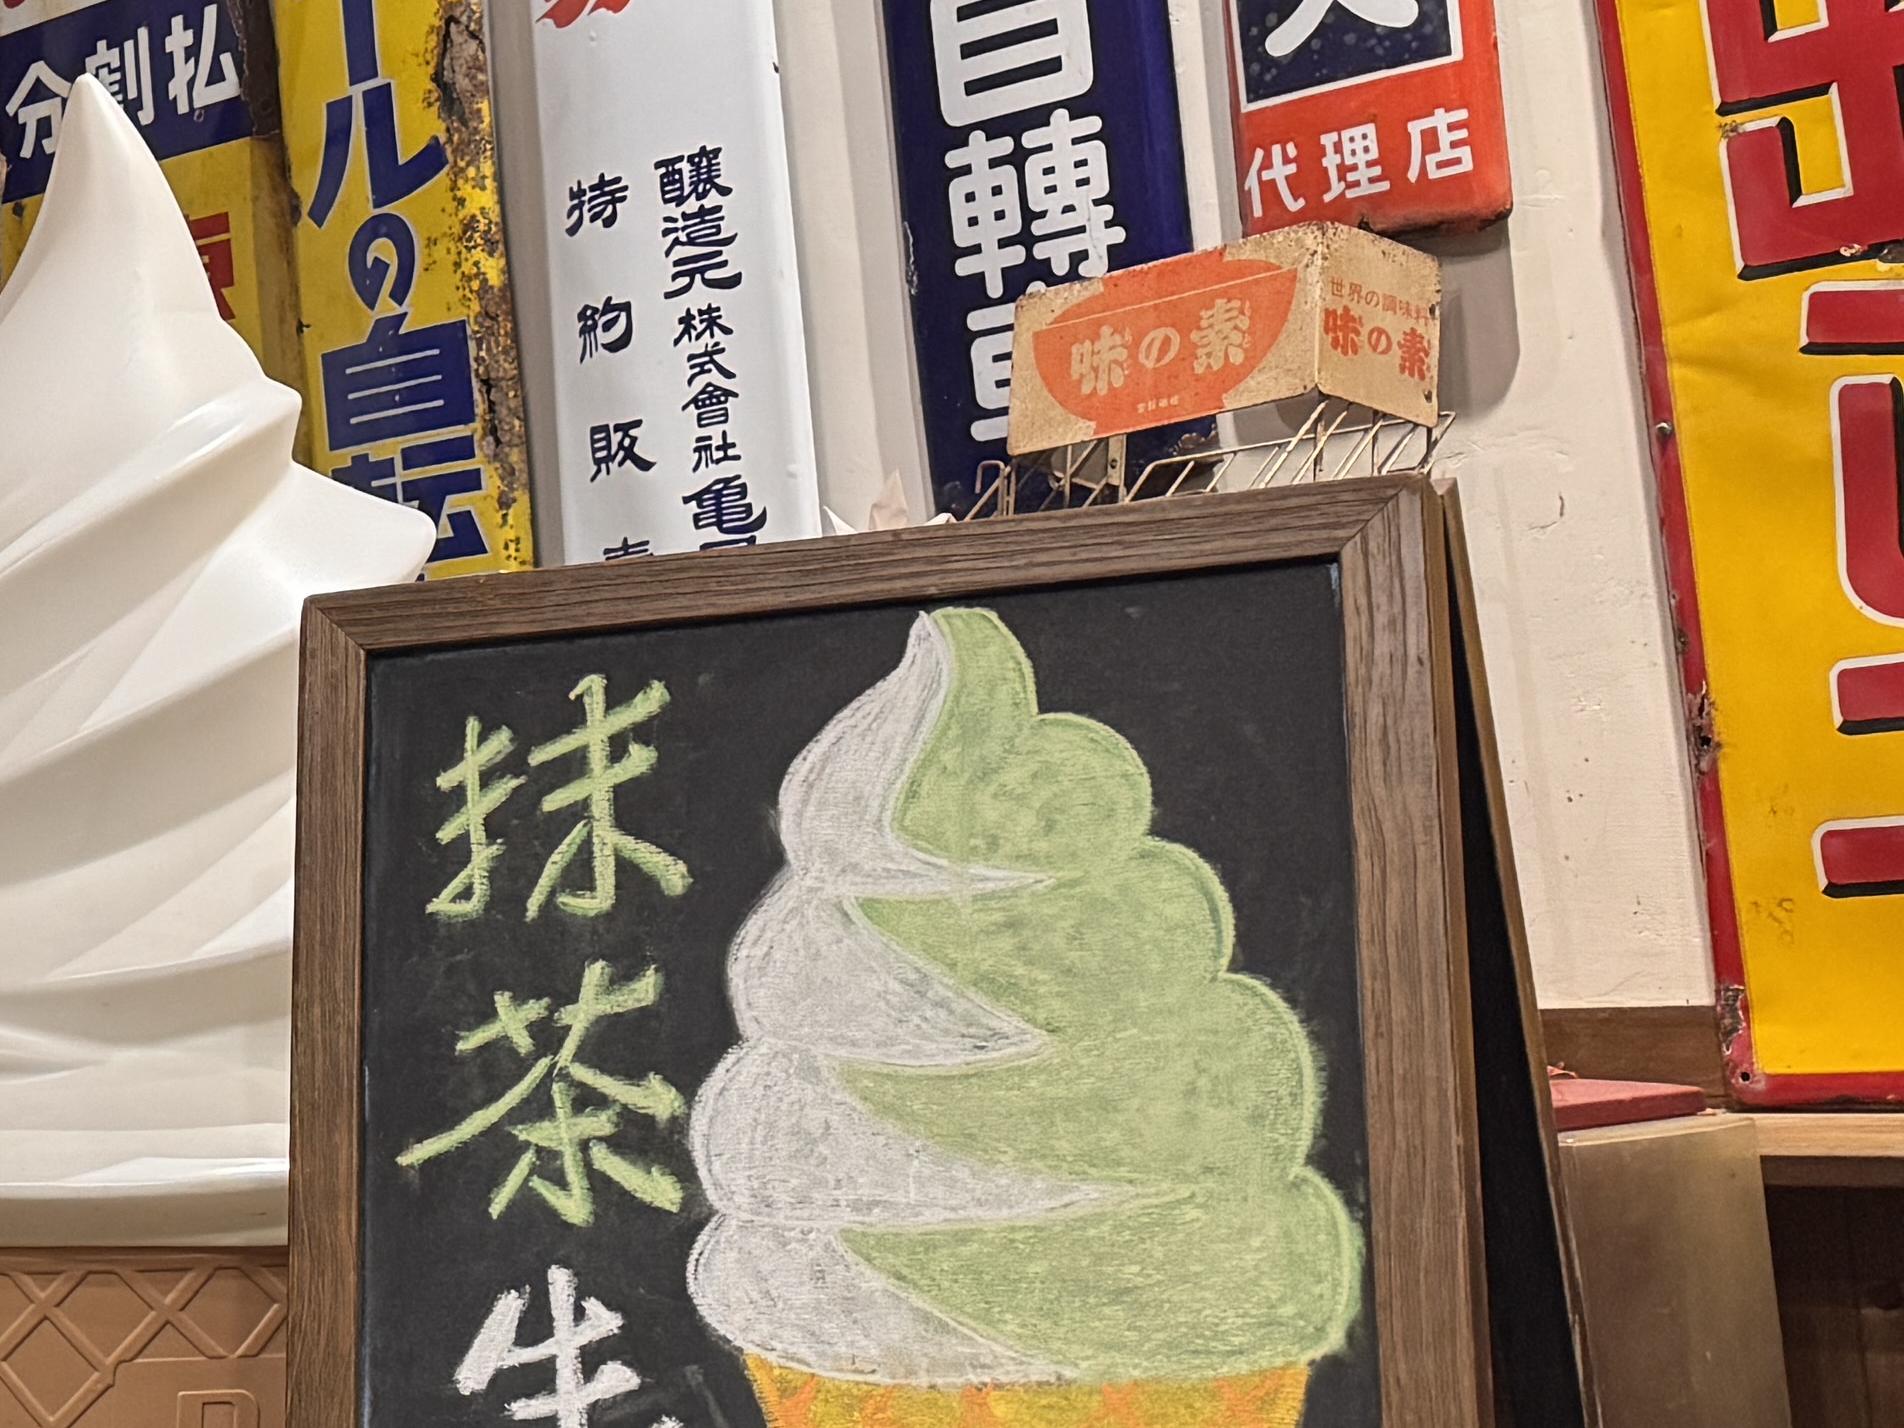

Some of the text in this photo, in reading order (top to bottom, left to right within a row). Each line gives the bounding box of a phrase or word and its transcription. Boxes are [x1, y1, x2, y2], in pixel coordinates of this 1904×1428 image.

[5, 2, 241, 160] 分割払
[1244, 108, 1475, 218] 代理店
[1070, 298, 1250, 396] 味の素
[1323, 305, 1431, 381] 味の素
